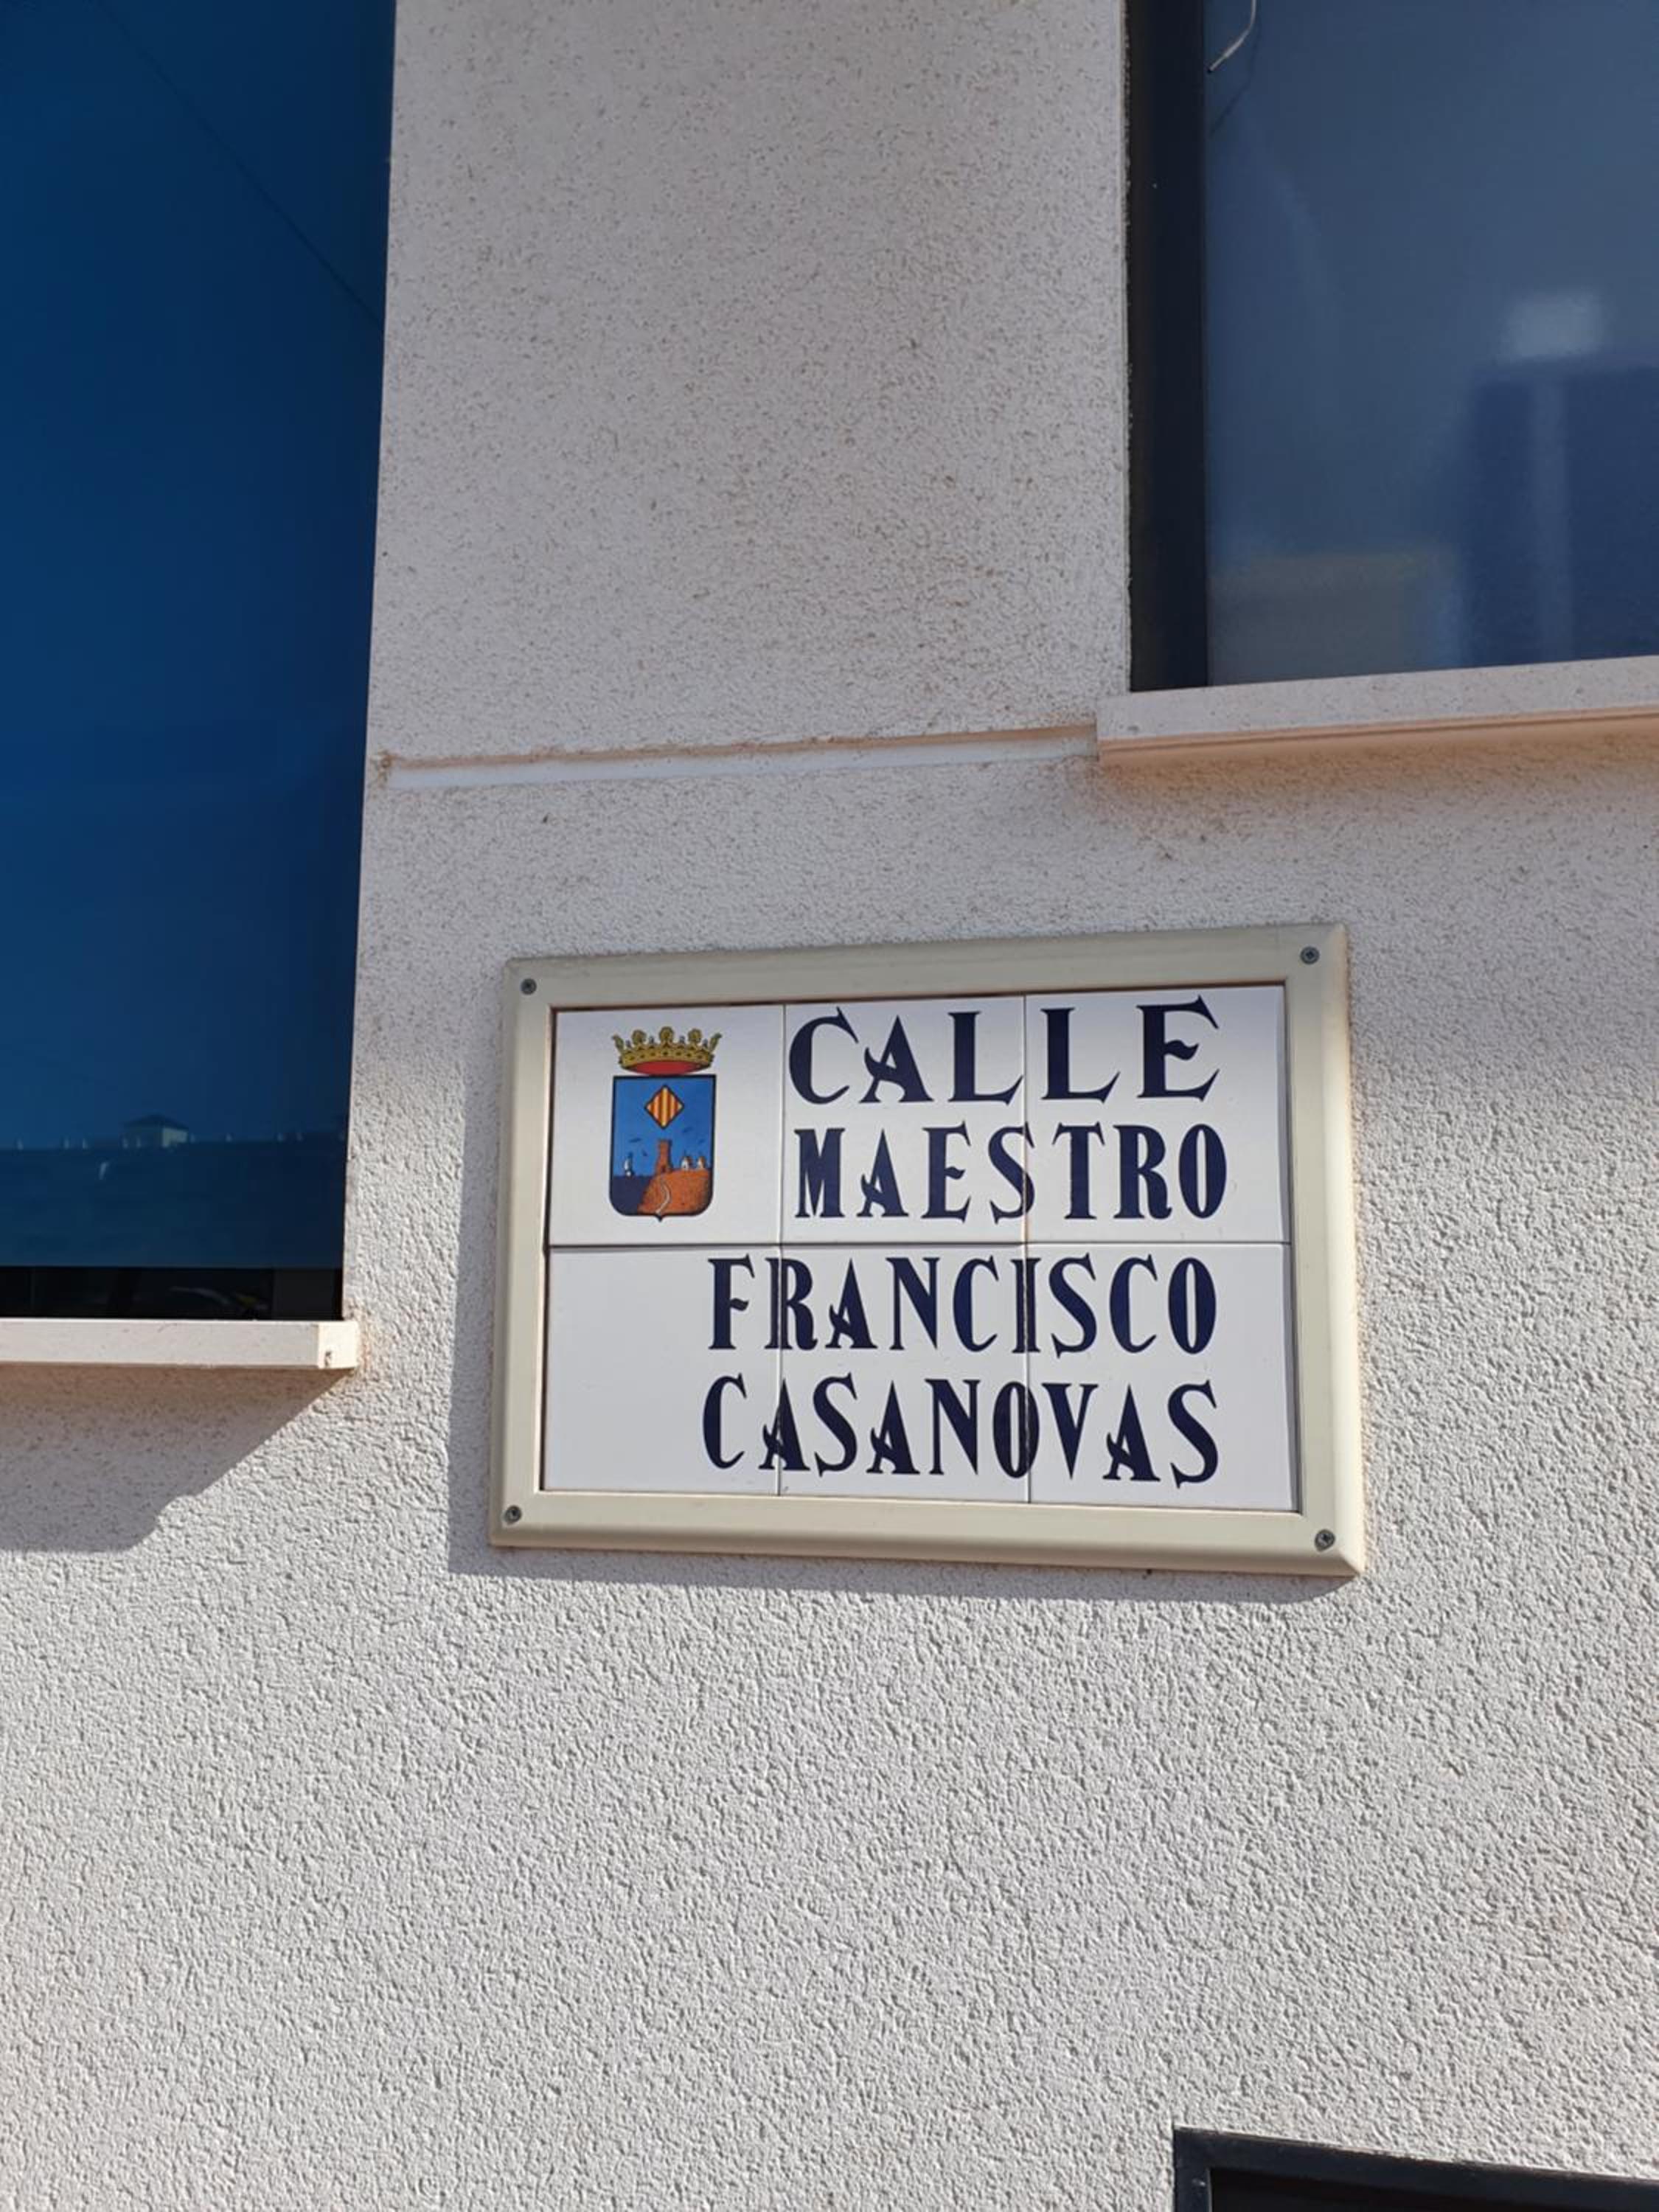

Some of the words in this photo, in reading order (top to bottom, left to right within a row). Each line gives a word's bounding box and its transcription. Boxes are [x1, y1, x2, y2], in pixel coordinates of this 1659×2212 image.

[788, 995, 1220, 1105] CALLE
[794, 1121, 1227, 1224] MAESTRO
[707, 1253, 1217, 1358] FRANCISCO
[702, 1372, 1218, 1489] CASANOVAS
